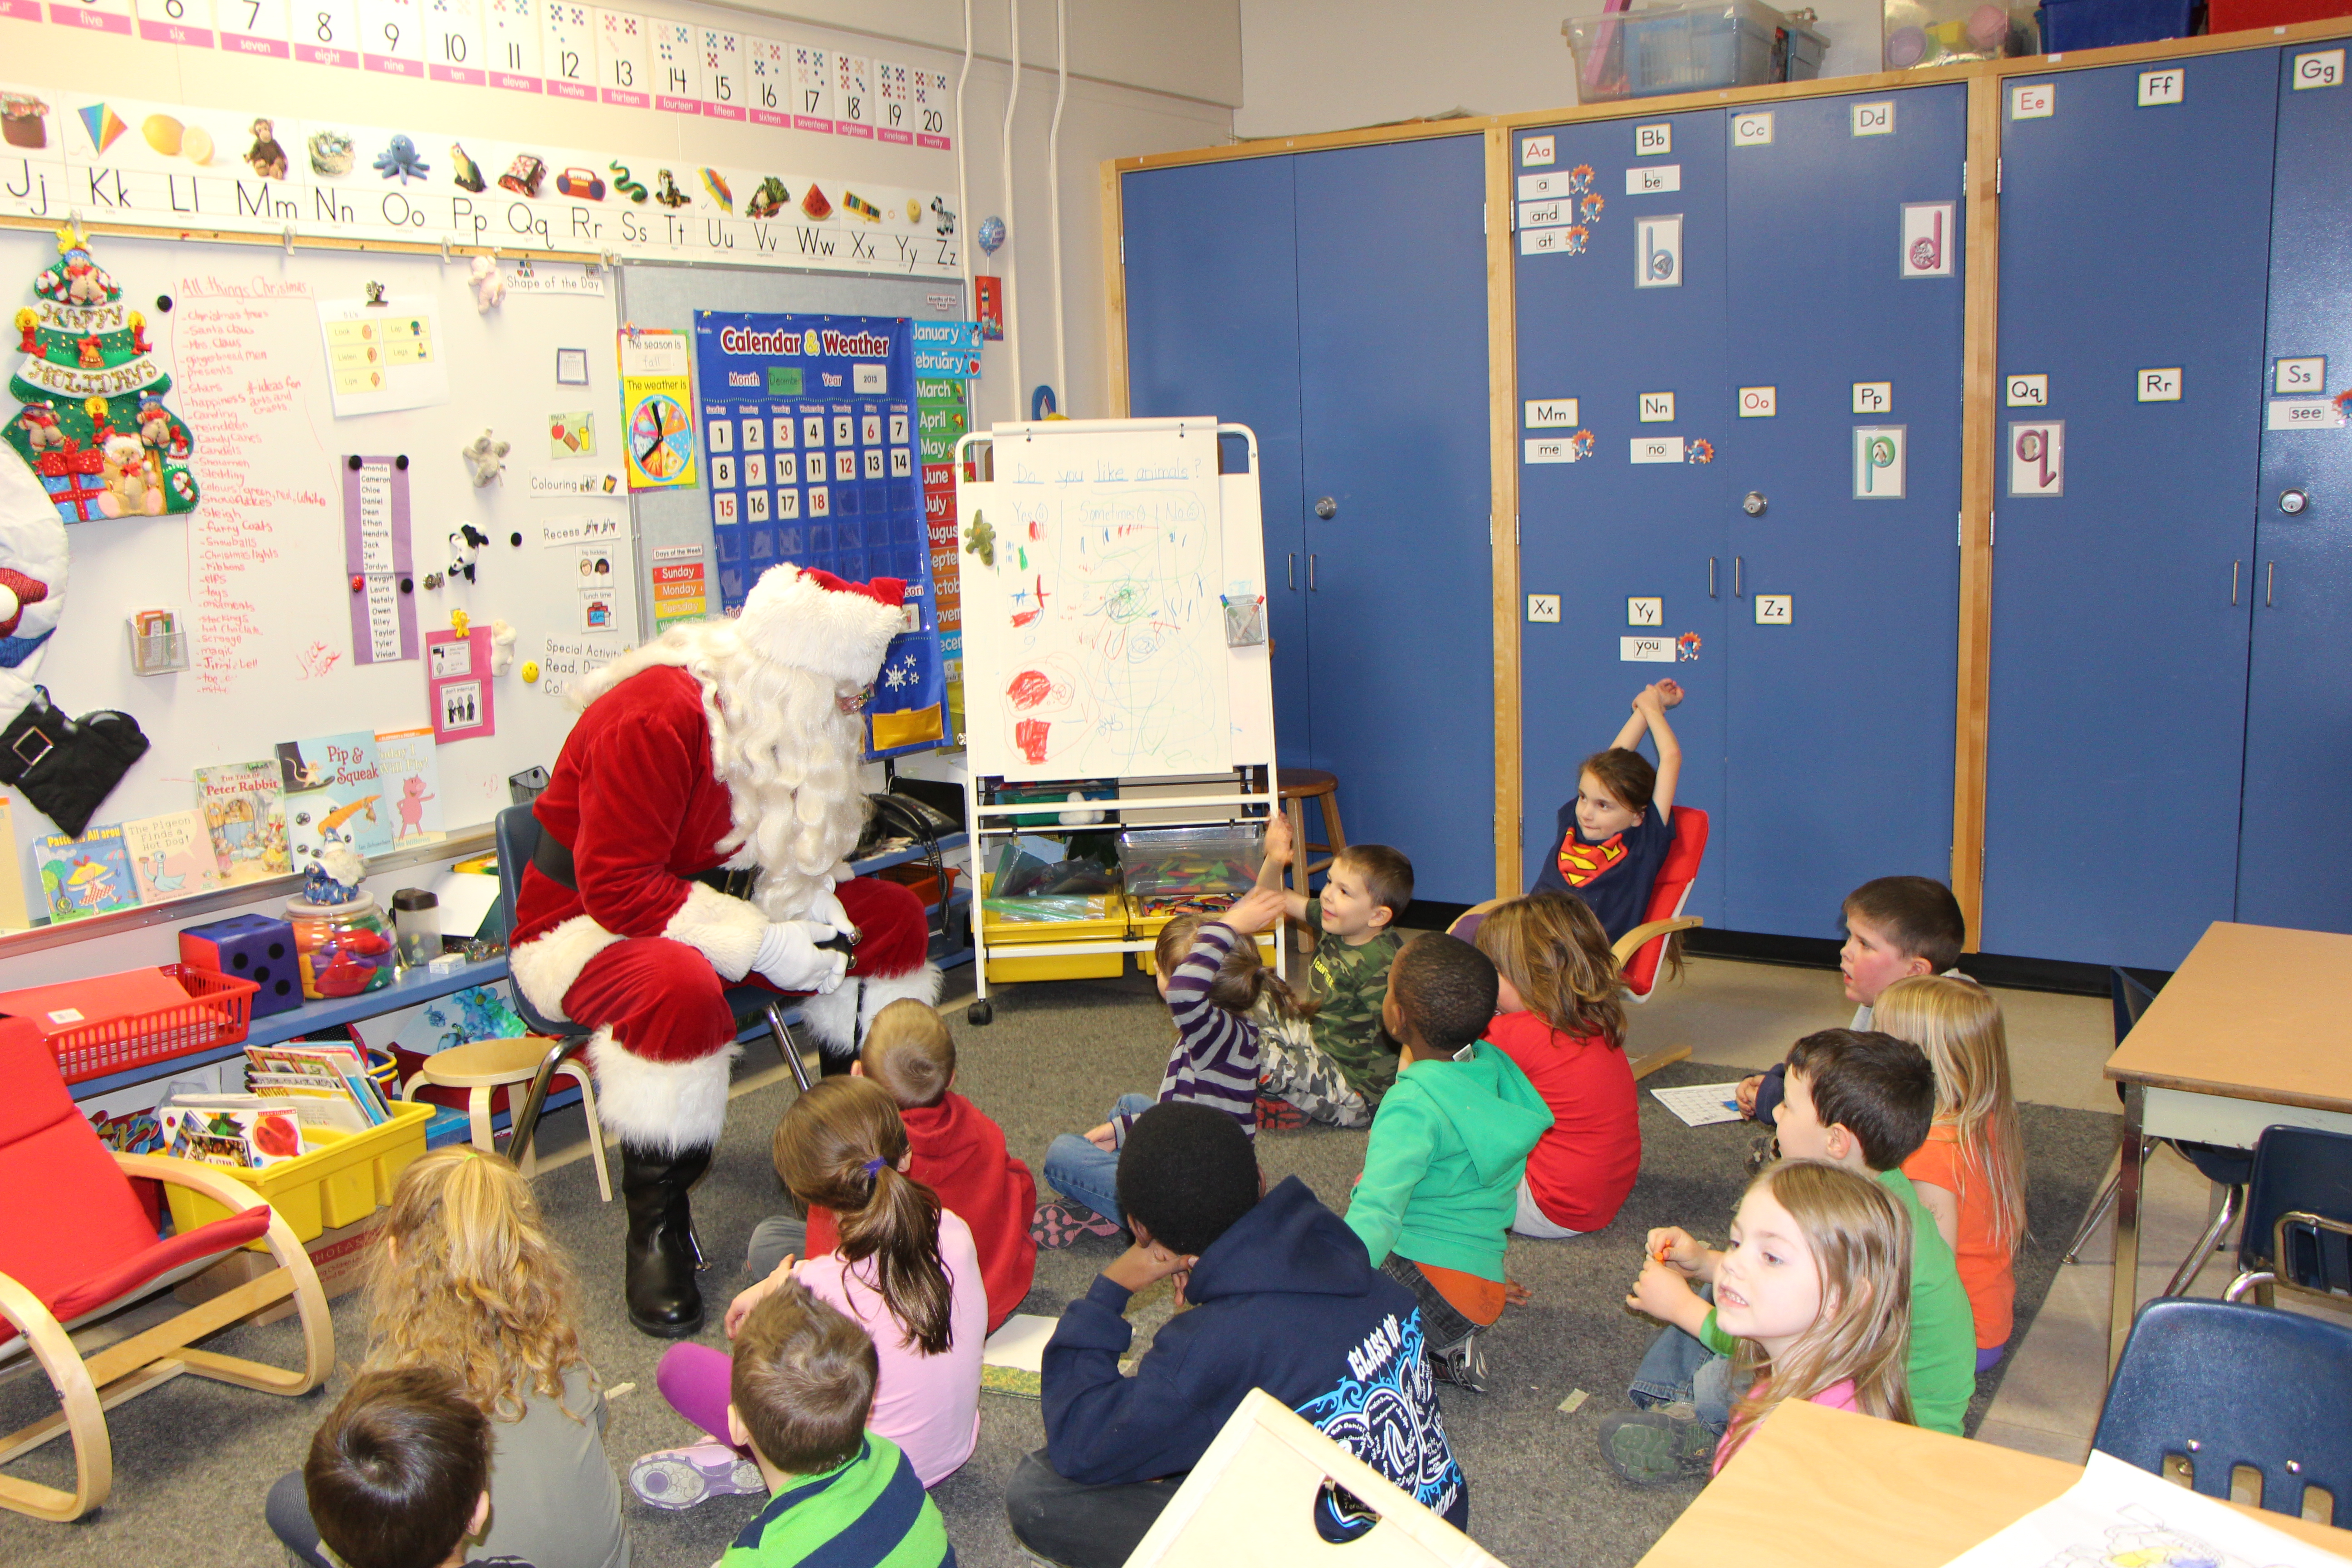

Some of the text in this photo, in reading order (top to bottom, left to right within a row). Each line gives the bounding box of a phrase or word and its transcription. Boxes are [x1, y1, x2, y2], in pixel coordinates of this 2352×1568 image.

[81, 11, 103, 28] five
[318, 12, 332, 42] 8
[241, 38, 270, 53] seven
[385, 23, 399, 51] 9
[446, 33, 466, 62] 10
[315, 49, 340, 65] eight
[510, 43, 520, 70] 11
[562, 51, 579, 78] 12
[616, 59, 632, 87] 13
[2302, 59, 2334, 83] Gg
[503, 77, 529, 89] eleven
[670, 68, 686, 93] 14
[716, 75, 731, 101] 15
[2150, 76, 2172, 96] Ff
[559, 84, 584, 97] twelve
[611, 91, 640, 105] thirteen
[762, 83, 777, 108] 16
[664, 99, 693, 111] fourteen
[805, 89, 819, 113] 17
[848, 96, 860, 120] 18
[2021, 93, 2044, 110] Ee
[759, 113, 781, 125] sixteen
[889, 103, 901, 126] 19
[923, 109, 942, 132] 20
[1860, 110, 1886, 127] Dd
[798, 120, 828, 131] seventeen
[842, 124, 867, 136] eighteen
[924, 138, 943, 148] twenty
[1642, 130, 1665, 147] Bb
[1526, 142, 1550, 158] Aa
[89, 167, 131, 208] Kk
[1539, 181, 1546, 190] a
[1644, 173, 1660, 188] be
[237, 180, 298, 219] Mm
[382, 192, 425, 226] Oo
[1533, 206, 1557, 221] and
[453, 197, 487, 245] Pp
[508, 202, 554, 250] Qq
[622, 211, 647, 242] Ss
[754, 223, 776, 251] Vv
[797, 225, 834, 256] Ww
[896, 235, 917, 273] Yy
[936, 239, 956, 265] Zz
[182, 276, 306, 304] All things Christmas
[508, 275, 599, 292] Shape of the Day
[40, 304, 123, 329] HAPPY
[188, 309, 241, 321] Christmas
[335, 328, 350, 337] Look
[391, 325, 402, 333] Lap
[913, 323, 960, 345] January
[628, 339, 673, 350] The season
[720, 325, 889, 357] Calendar & Weather
[338, 353, 357, 362] Listen
[643, 354, 660, 368] fall
[914, 351, 963, 374] ebruary
[29, 359, 157, 394] HOLIDAYS
[729, 371, 760, 387] Month
[769, 372, 802, 385] December
[822, 372, 842, 387] Year
[2288, 365, 2311, 383] Ss
[627, 380, 678, 391] The weather
[916, 381, 951, 398] March
[2147, 375, 2172, 392] Rr
[1744, 393, 1769, 409] Oo
[1862, 389, 1882, 410] Pp
[2012, 382, 2042, 403] Qq
[191, 394, 245, 412] happiness
[1646, 399, 1667, 415] Nn
[920, 411, 946, 431] April
[1538, 406, 1566, 421] Mm
[2291, 407, 2321, 419] see
[780, 425, 788, 441] 3
[867, 423, 874, 439] 6
[896, 422, 902, 437] 7
[921, 438, 946, 459] May
[1539, 446, 1559, 455] me
[1648, 445, 1665, 455] no
[840, 457, 852, 473] 12
[894, 455, 906, 470] 14
[1865, 436, 1895, 493] p
[2016, 429, 2056, 487] q
[751, 463, 759, 479] 9
[779, 460, 792, 476] 10
[924, 468, 949, 485] June
[1018, 462, 1036, 483] Do
[1058, 470, 1083, 489] you
[1098, 459, 1124, 481] like
[532, 477, 577, 492] Colouring
[719, 500, 734, 516] 15
[812, 494, 825, 510] 18
[925, 494, 947, 515] July
[1166, 502, 1183, 519] No
[1013, 501, 1032, 522] Yes
[1079, 501, 1134, 521] Sometimes
[206, 536, 256, 546] Snowballs
[544, 527, 579, 539] Recess
[252, 549, 278, 563] lights
[364, 563, 388, 572] Jordyn
[662, 565, 694, 579] Sunday
[663, 583, 696, 595] Monday
[662, 602, 698, 612] Tuesday
[1635, 603, 1654, 622] Yy
[1764, 601, 1784, 616] Zz
[373, 618, 390, 627] Riley
[375, 639, 393, 649] Tyler
[547, 638, 582, 655] Special
[1636, 640, 1659, 657] you
[376, 650, 396, 658] Vivian
[546, 657, 578, 675] Read,
[327, 746, 363, 765] Pip &
[406, 757, 428, 772] Fly!
[337, 762, 379, 787] Squeak
[207, 779, 278, 796] Peter Rabbit
[128, 817, 191, 834] The Pigeon
[87, 829, 99, 841] All
[142, 831, 173, 842] Finds
[144, 836, 190, 851] Hot Dog!
[1347, 1326, 1392, 1382] CLASS
[1383, 1313, 1401, 1349] OF
[1344, 1423, 1365, 1434] Daniel
